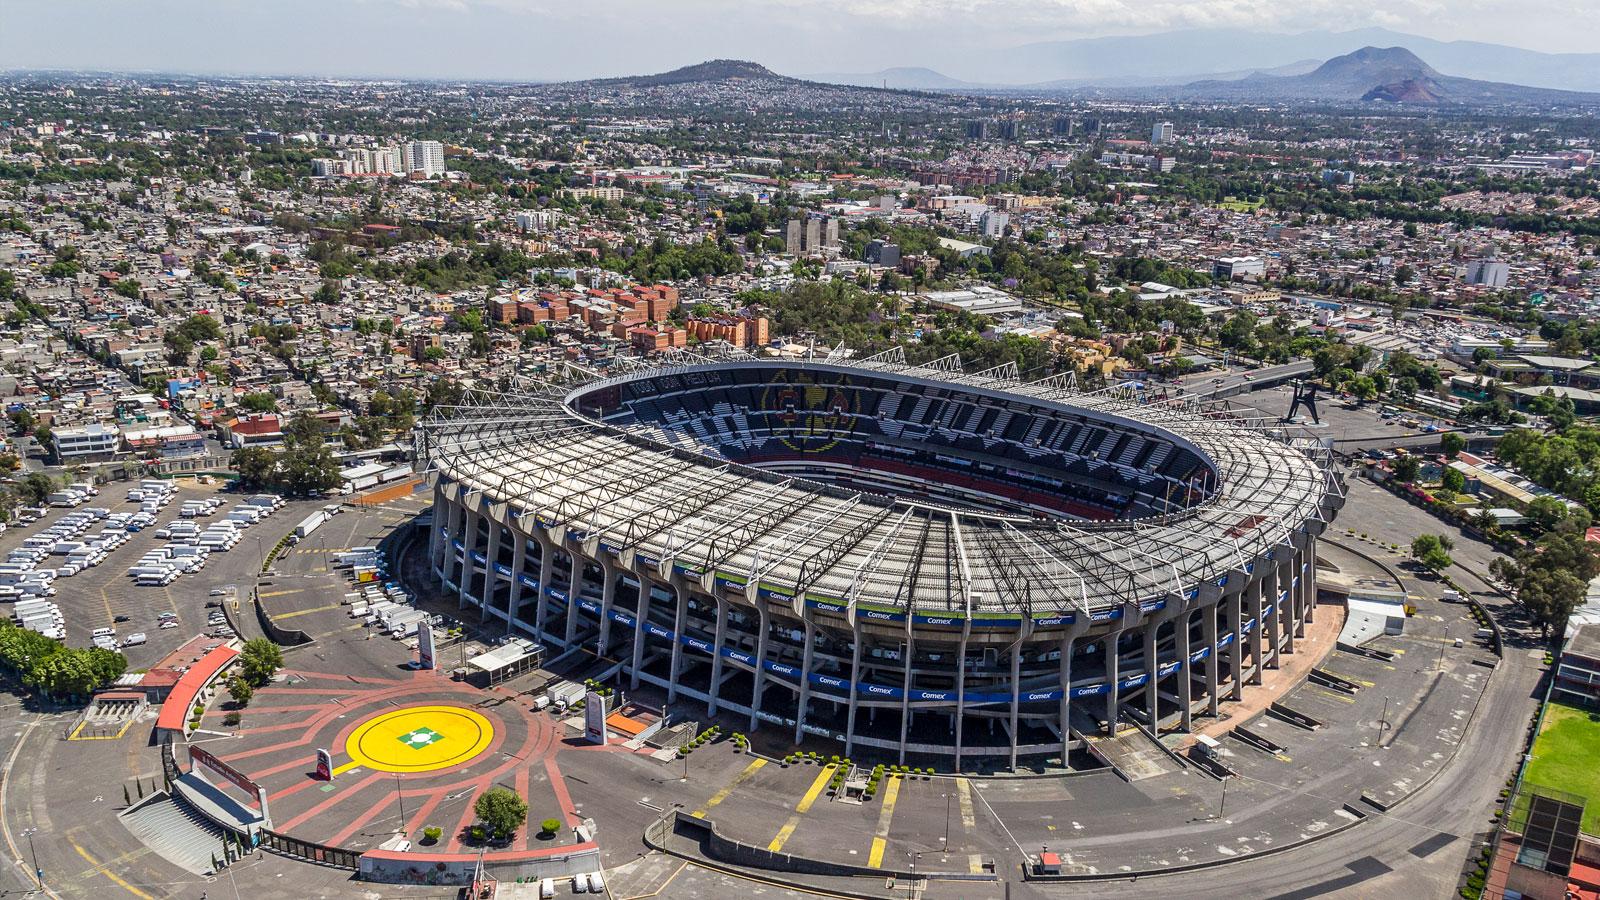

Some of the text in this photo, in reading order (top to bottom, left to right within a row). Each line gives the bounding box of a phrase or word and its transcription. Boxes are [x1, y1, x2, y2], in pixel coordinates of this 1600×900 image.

[770, 592, 791, 602] Comex
[582, 602, 597, 612] Comex
[818, 603, 839, 612] Comex
[615, 614, 632, 624] Comex
[867, 612, 892, 620] Comex
[650, 627, 668, 637] Comex
[689, 639, 708, 649] Comex
[730, 652, 750, 662] Comex
[772, 664, 793, 674] Comex
[819, 676, 842, 686] Comex
[869, 686, 894, 695] Comex
